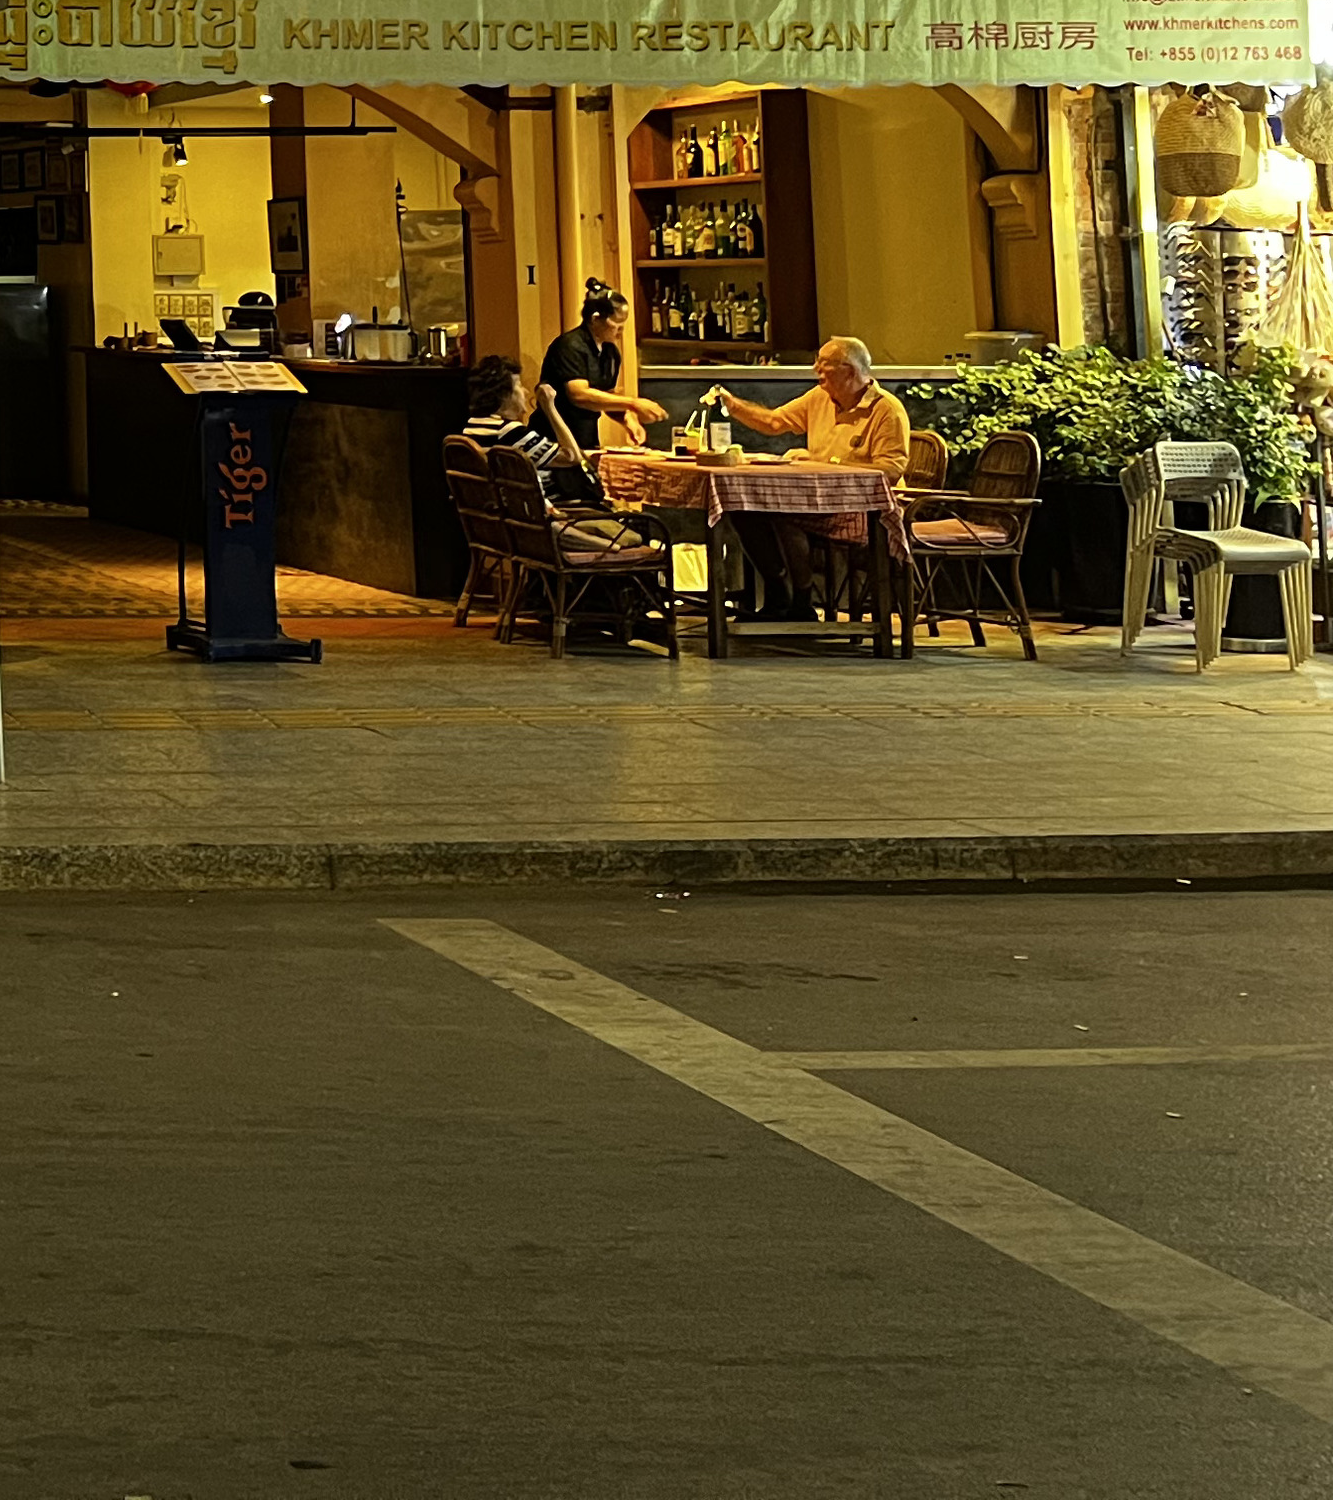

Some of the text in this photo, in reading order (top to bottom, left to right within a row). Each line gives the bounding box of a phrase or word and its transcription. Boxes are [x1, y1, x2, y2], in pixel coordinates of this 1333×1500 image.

[283, 18, 894, 52] KHMER KITCHEN RESTAURANT
[923, 20, 1099, 51] 高棉厨房
[1123, 16, 1299, 31] www.khmerkitchens.com
[1126, 46, 1303, 64] Tel: +855 (0)12 763 468
[218, 421, 268, 529] Tiger
